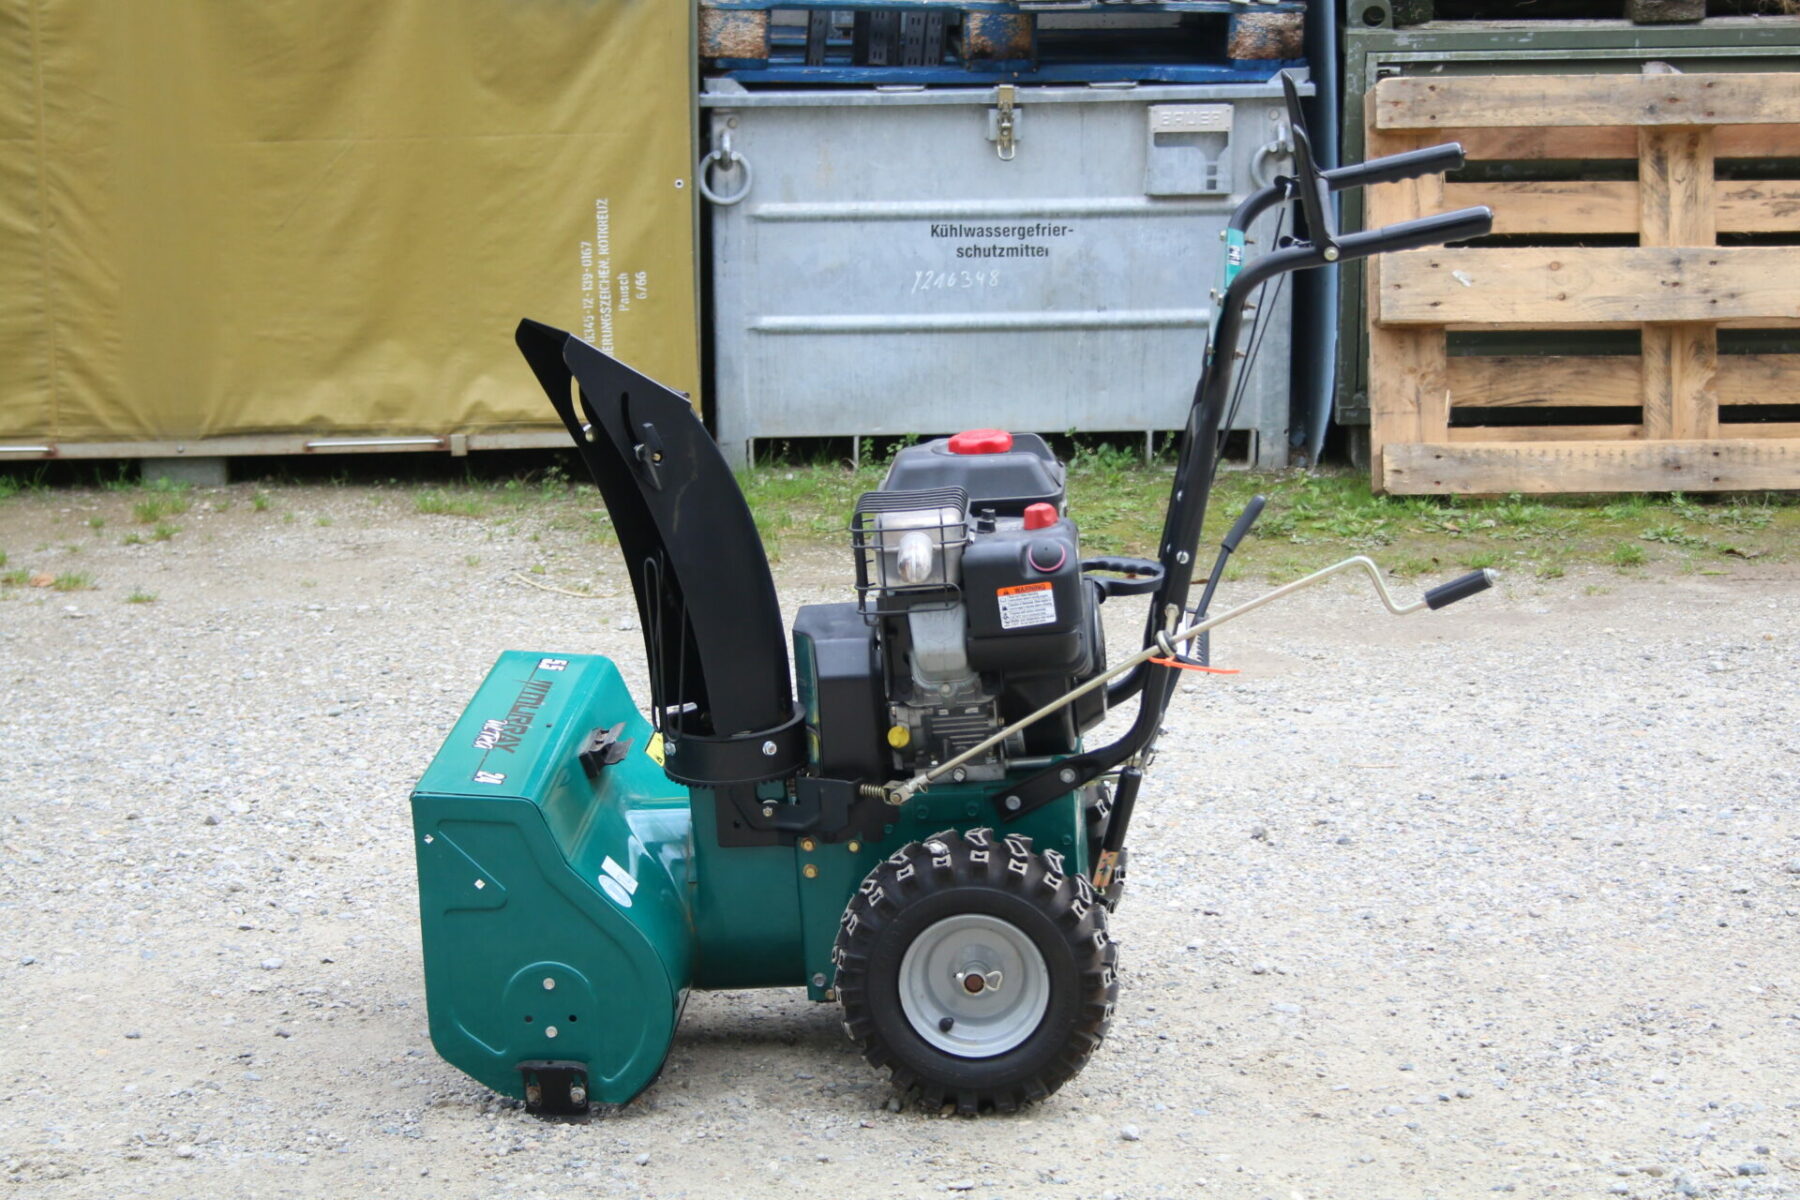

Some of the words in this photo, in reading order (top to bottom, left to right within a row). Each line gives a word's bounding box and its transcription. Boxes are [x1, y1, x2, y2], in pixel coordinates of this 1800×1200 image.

[596, 198, 609, 255] ROTKREUZ
[930, 223, 1074, 240] Kühlwassergefrier-
[495, 690, 546, 753] MURRAY
